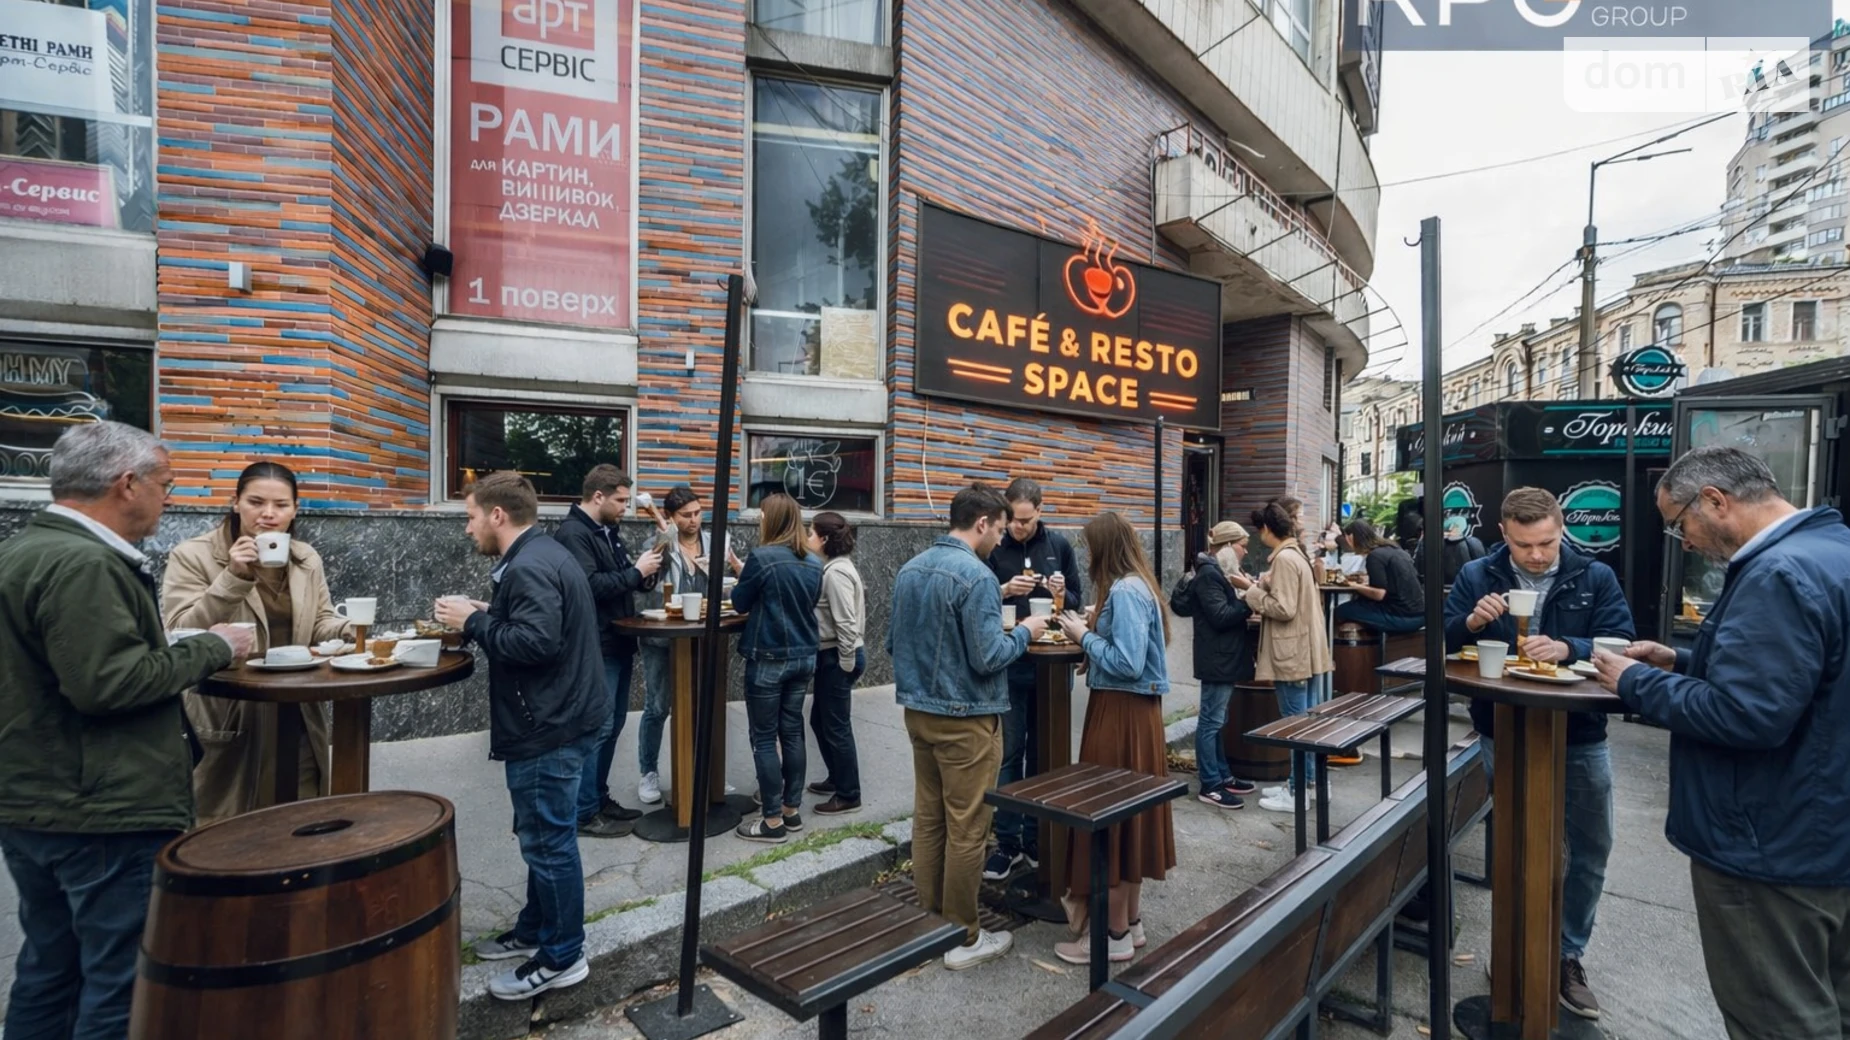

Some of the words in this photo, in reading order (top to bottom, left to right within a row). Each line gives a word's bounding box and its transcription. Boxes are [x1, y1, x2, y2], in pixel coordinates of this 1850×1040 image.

[501, 45, 596, 82] СЕРВІС
[470, 102, 621, 162] РАМИ
[0, 178, 100, 203] -Сервис
[470, 159, 497, 171] для
[502, 157, 594, 188] КАРТИН,
[499, 200, 600, 229] ДЗЕРКАЛ
[502, 179, 620, 213] ВИШИВОК,
[468, 277, 491, 305] 1
[501, 285, 617, 319] поверх
[948, 303, 1050, 353] CAFÉ
[1060, 328, 1080, 358] &
[1091, 331, 1198, 378] RESTO
[1023, 363, 1139, 408] SPACE
